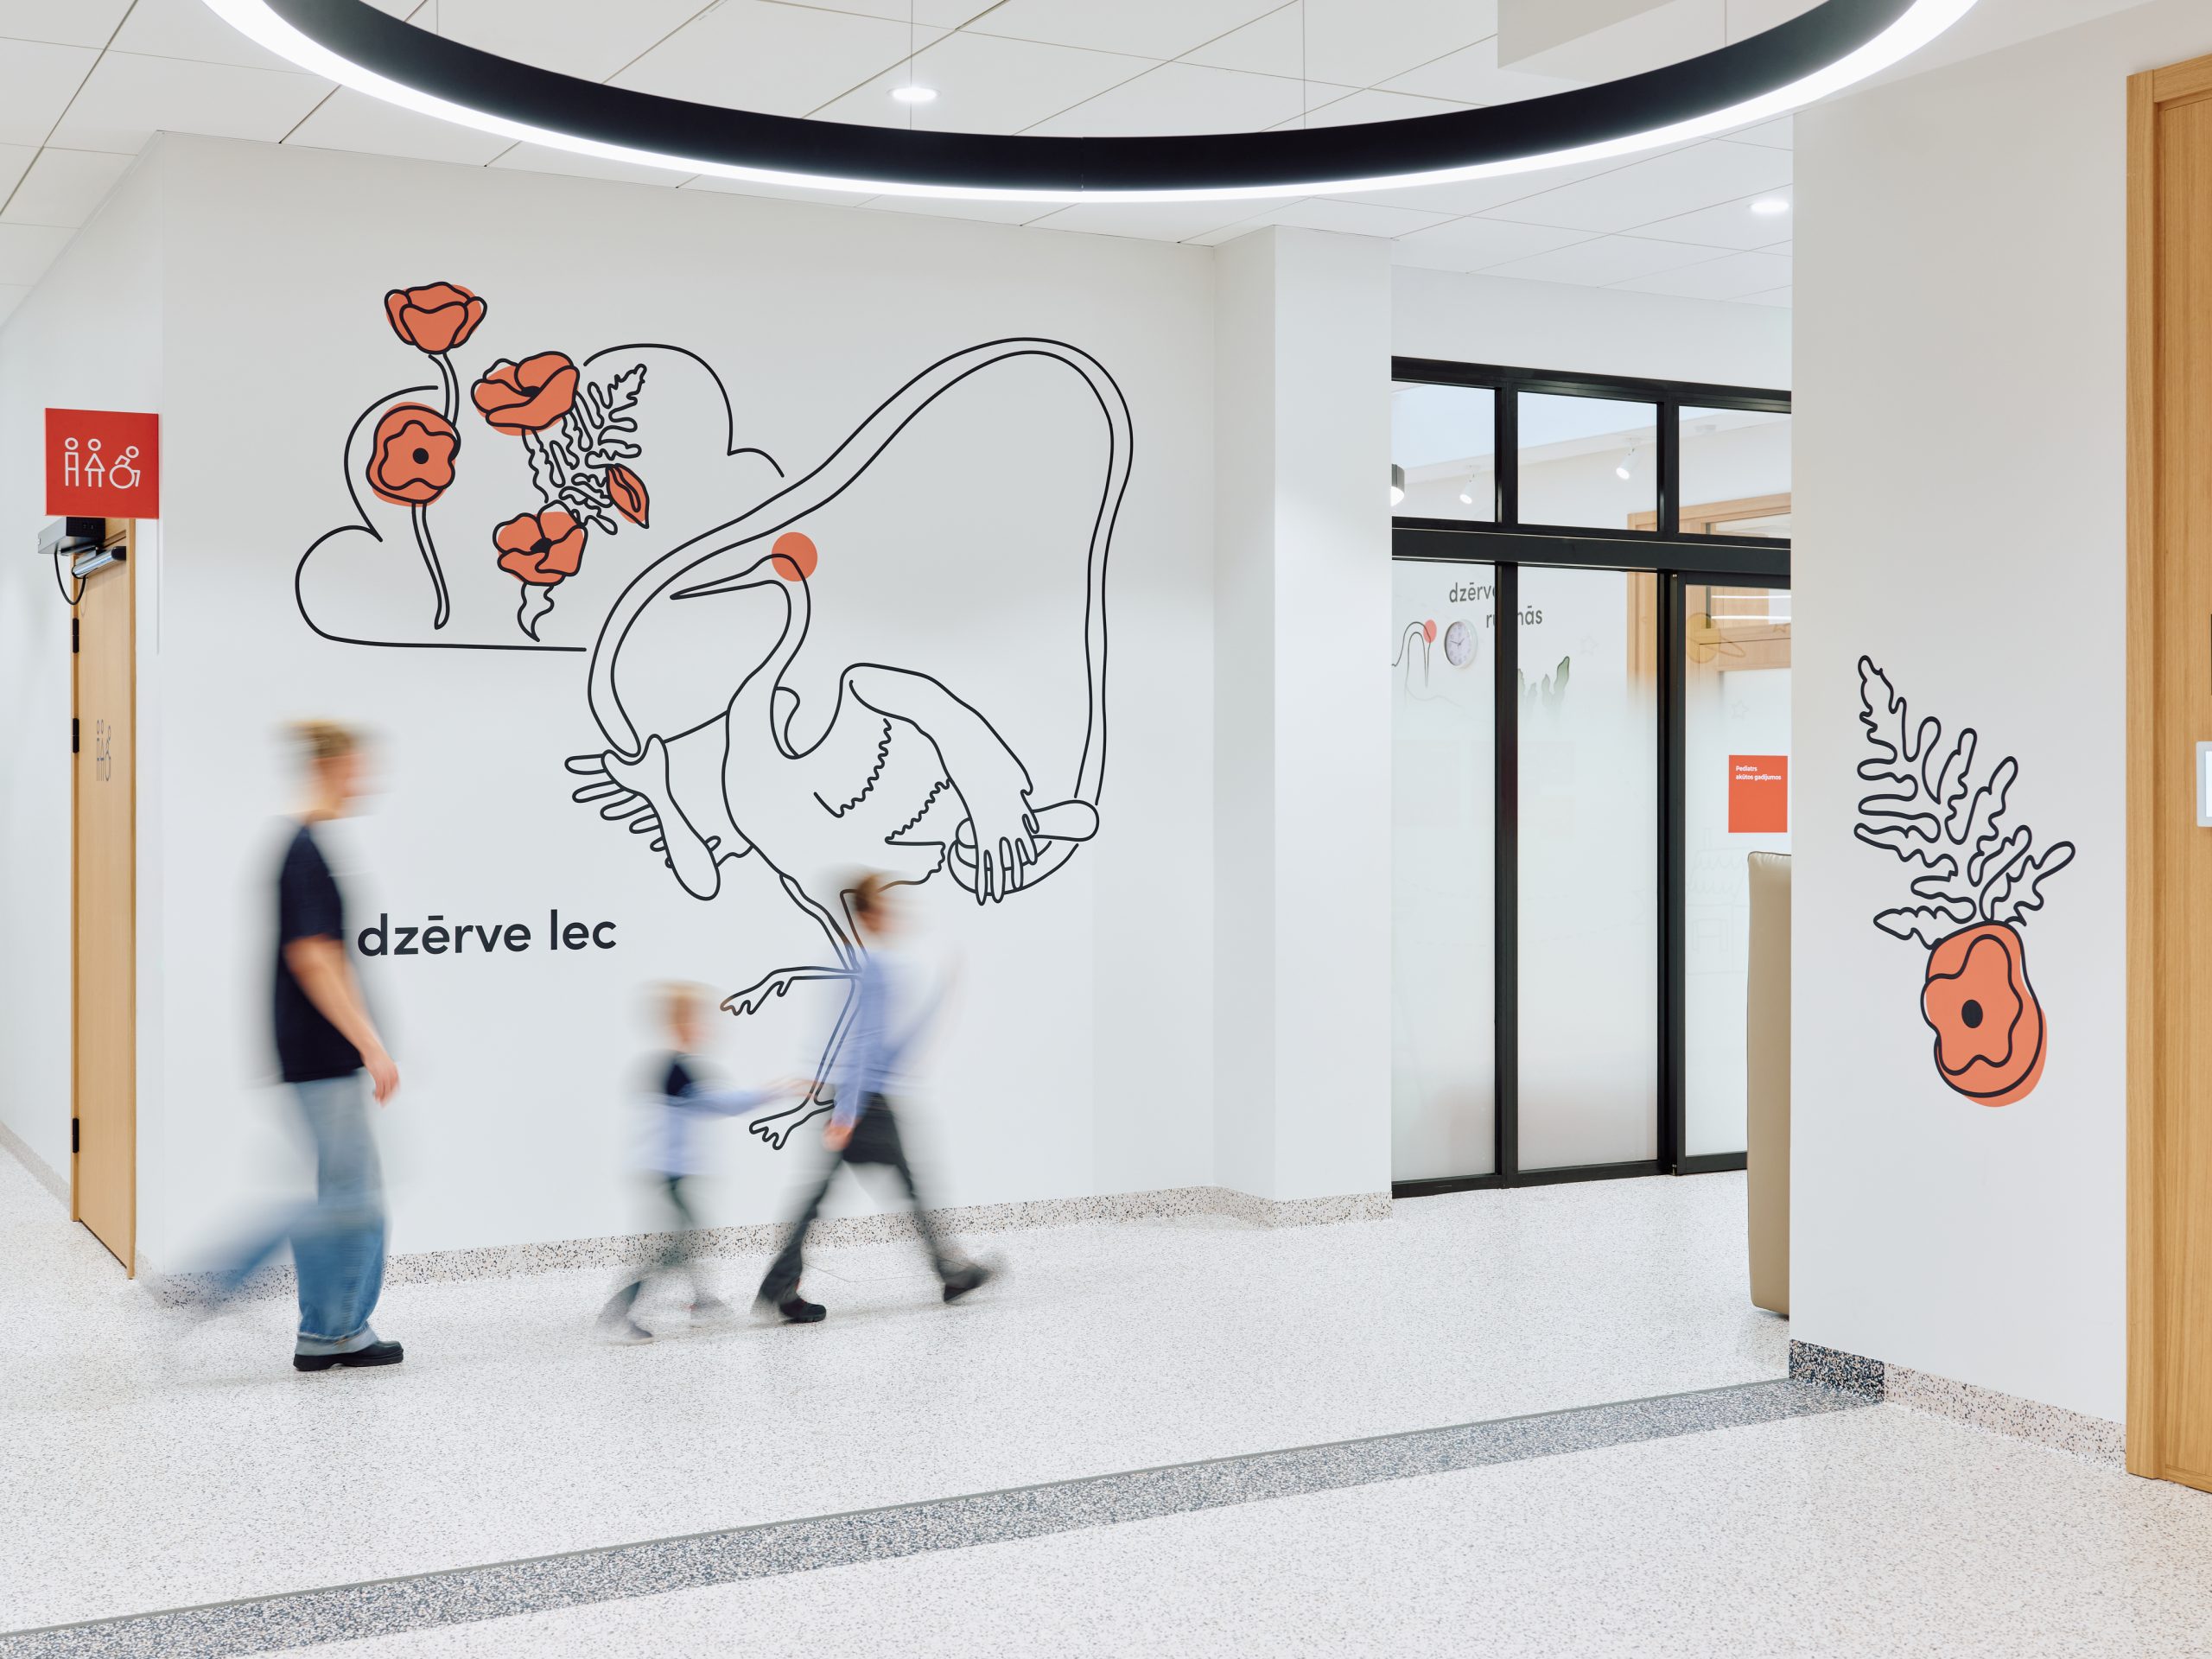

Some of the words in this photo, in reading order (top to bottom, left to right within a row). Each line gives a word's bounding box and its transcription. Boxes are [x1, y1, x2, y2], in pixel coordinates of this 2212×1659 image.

[1449, 582, 1495, 603] dzērv
[358, 912, 531, 957] dzērve
[550, 909, 617, 950] lec
